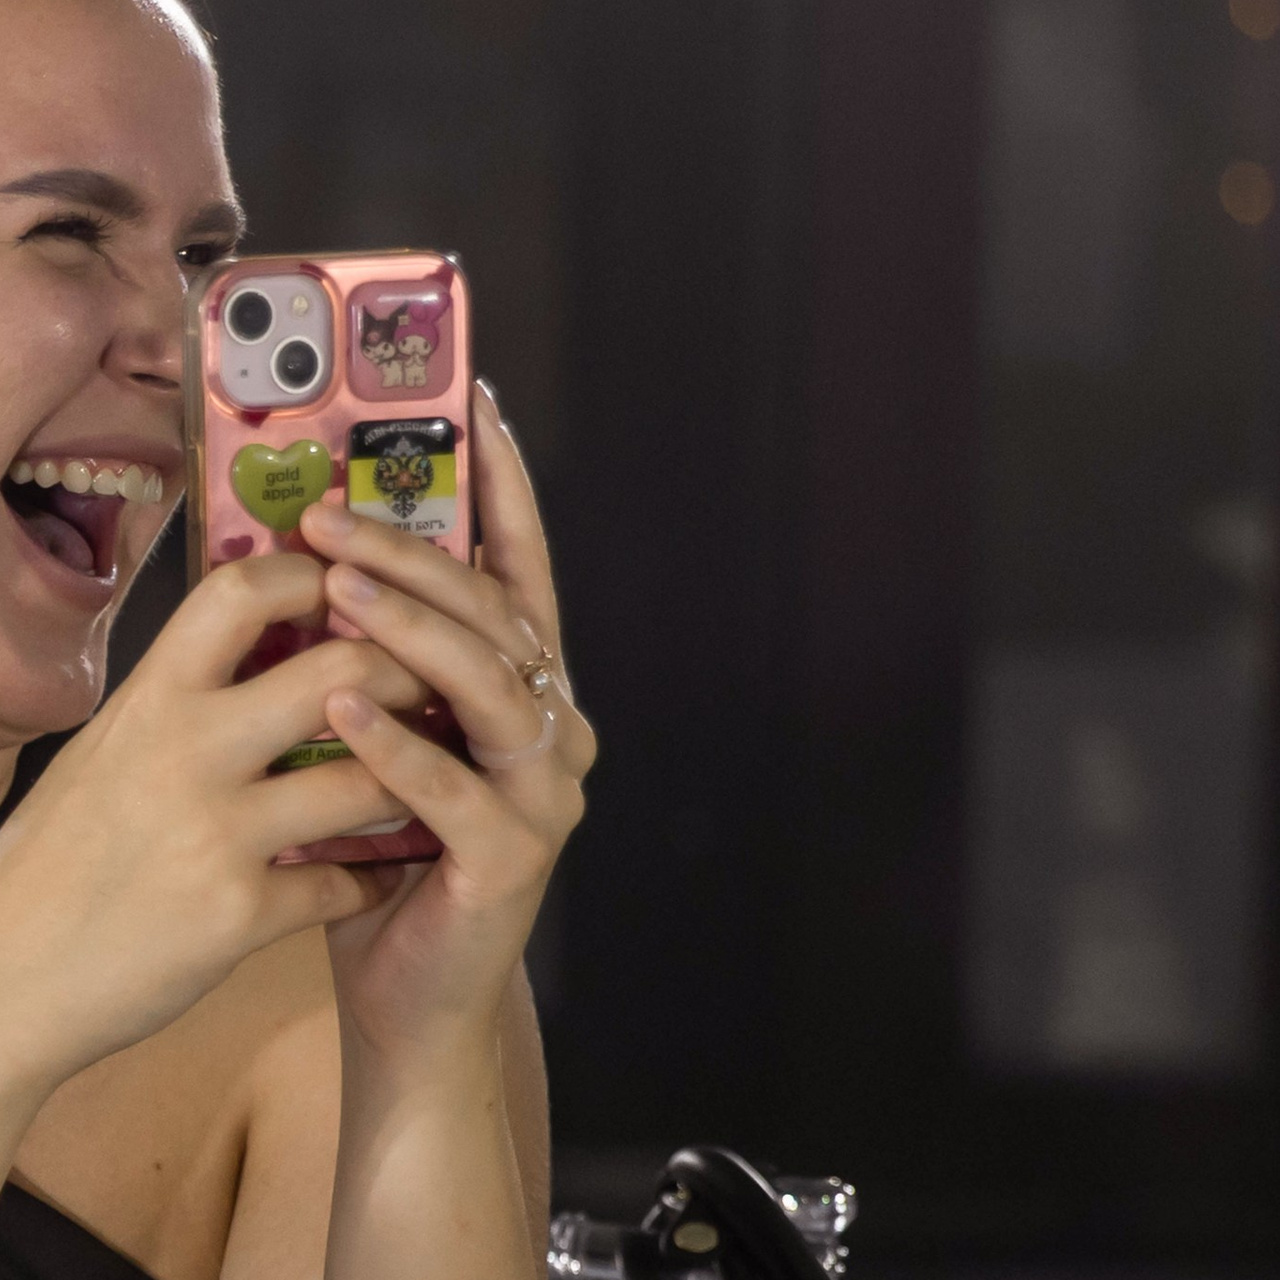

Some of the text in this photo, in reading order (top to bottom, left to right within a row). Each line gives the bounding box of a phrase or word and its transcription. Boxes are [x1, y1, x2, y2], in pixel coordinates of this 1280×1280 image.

[265, 467, 299, 487] gold
[262, 484, 304, 502] apple
[288, 747, 312, 762] old
